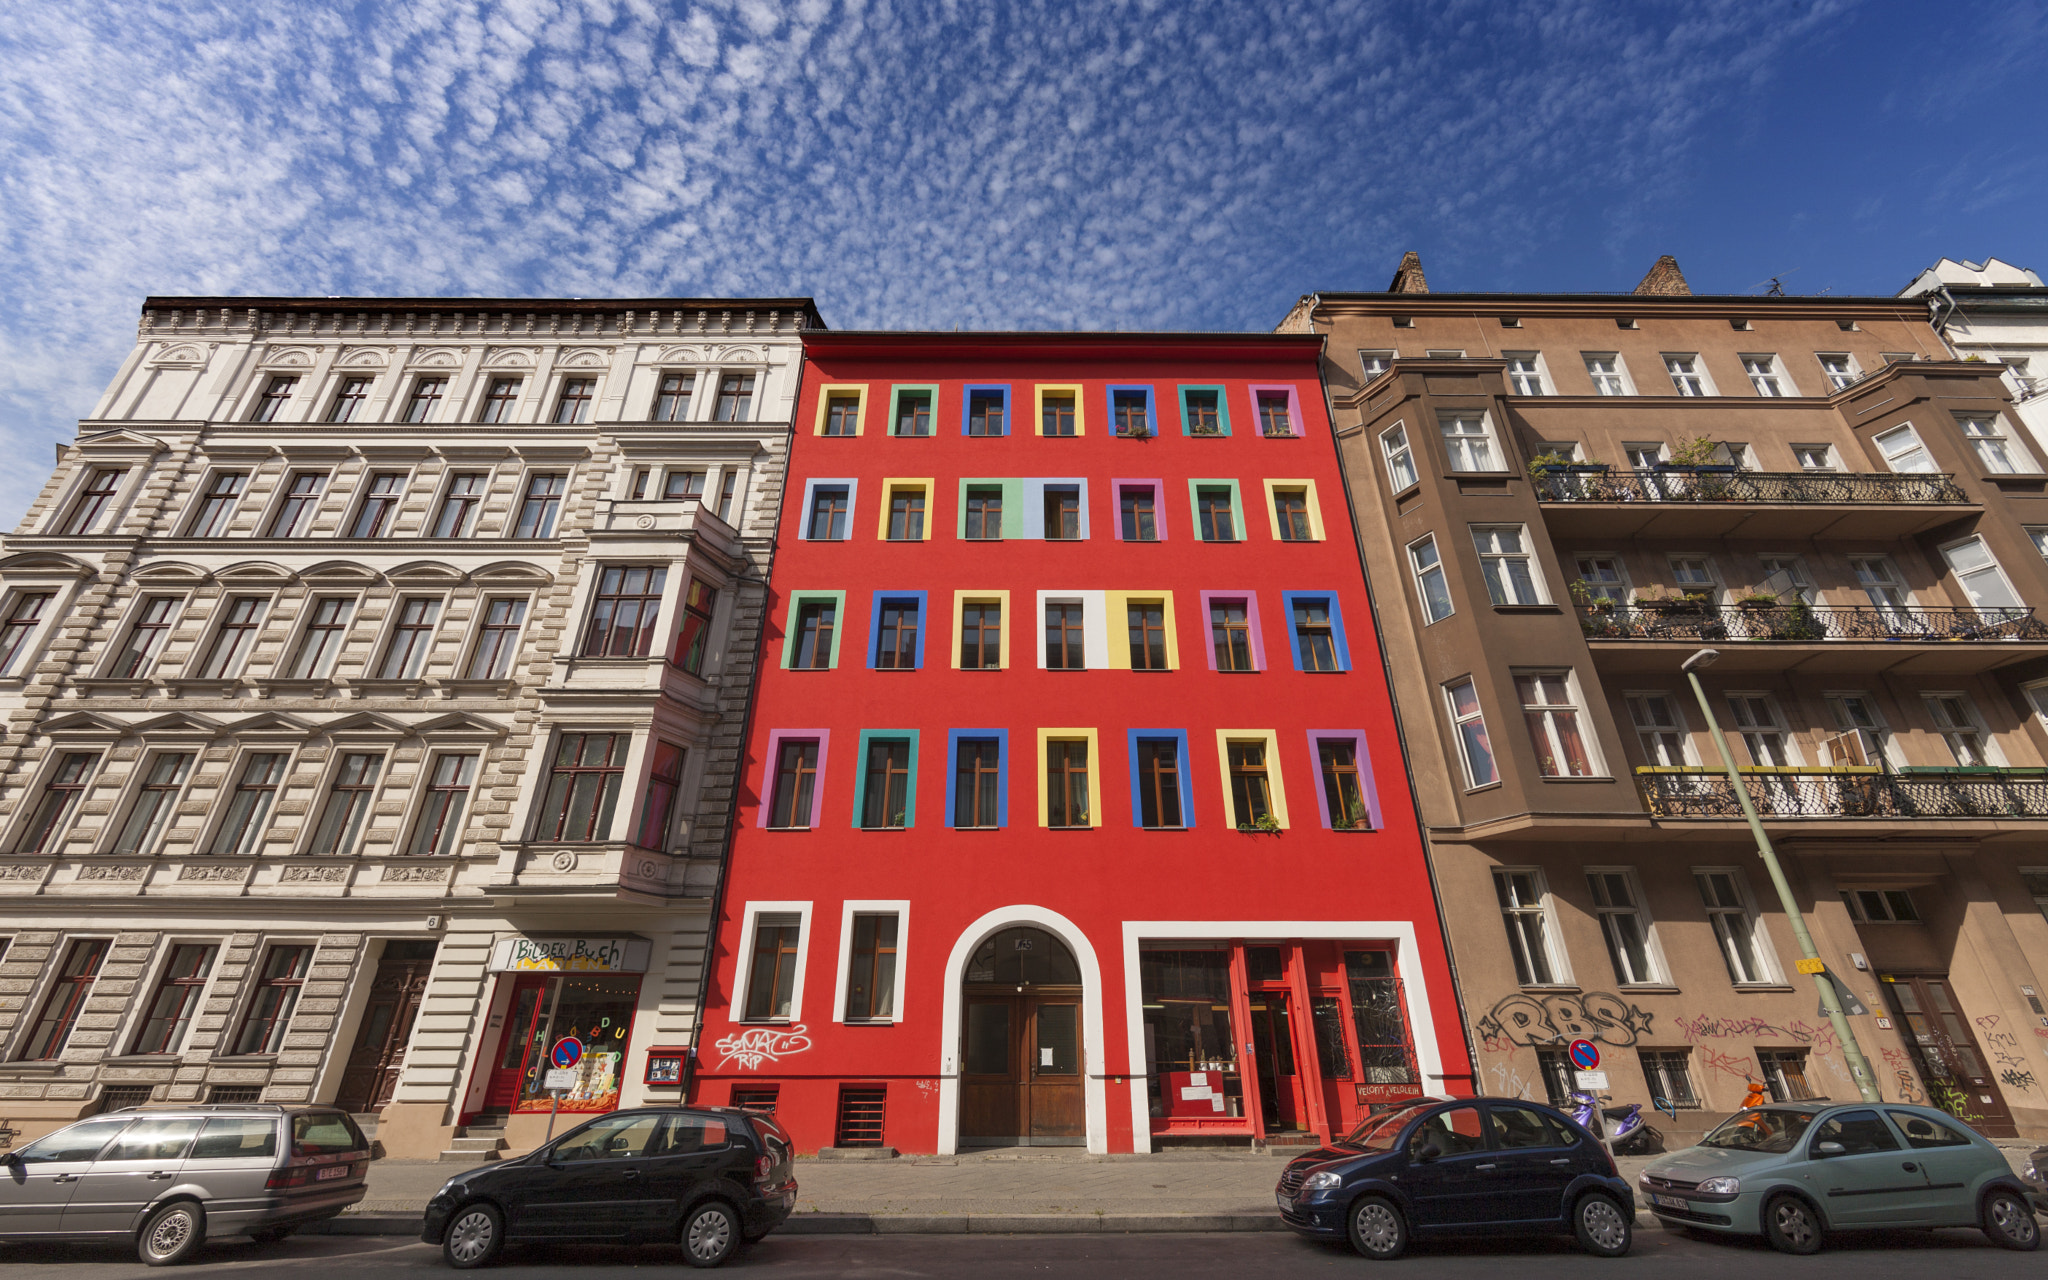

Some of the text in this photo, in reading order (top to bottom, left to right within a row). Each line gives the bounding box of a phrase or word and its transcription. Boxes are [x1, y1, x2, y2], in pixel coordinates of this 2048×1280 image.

[428, 917, 436, 927] 6
[519, 958, 601, 971] LADEN
[535, 1030, 545, 1042] H
[614, 1027, 626, 1039] U
